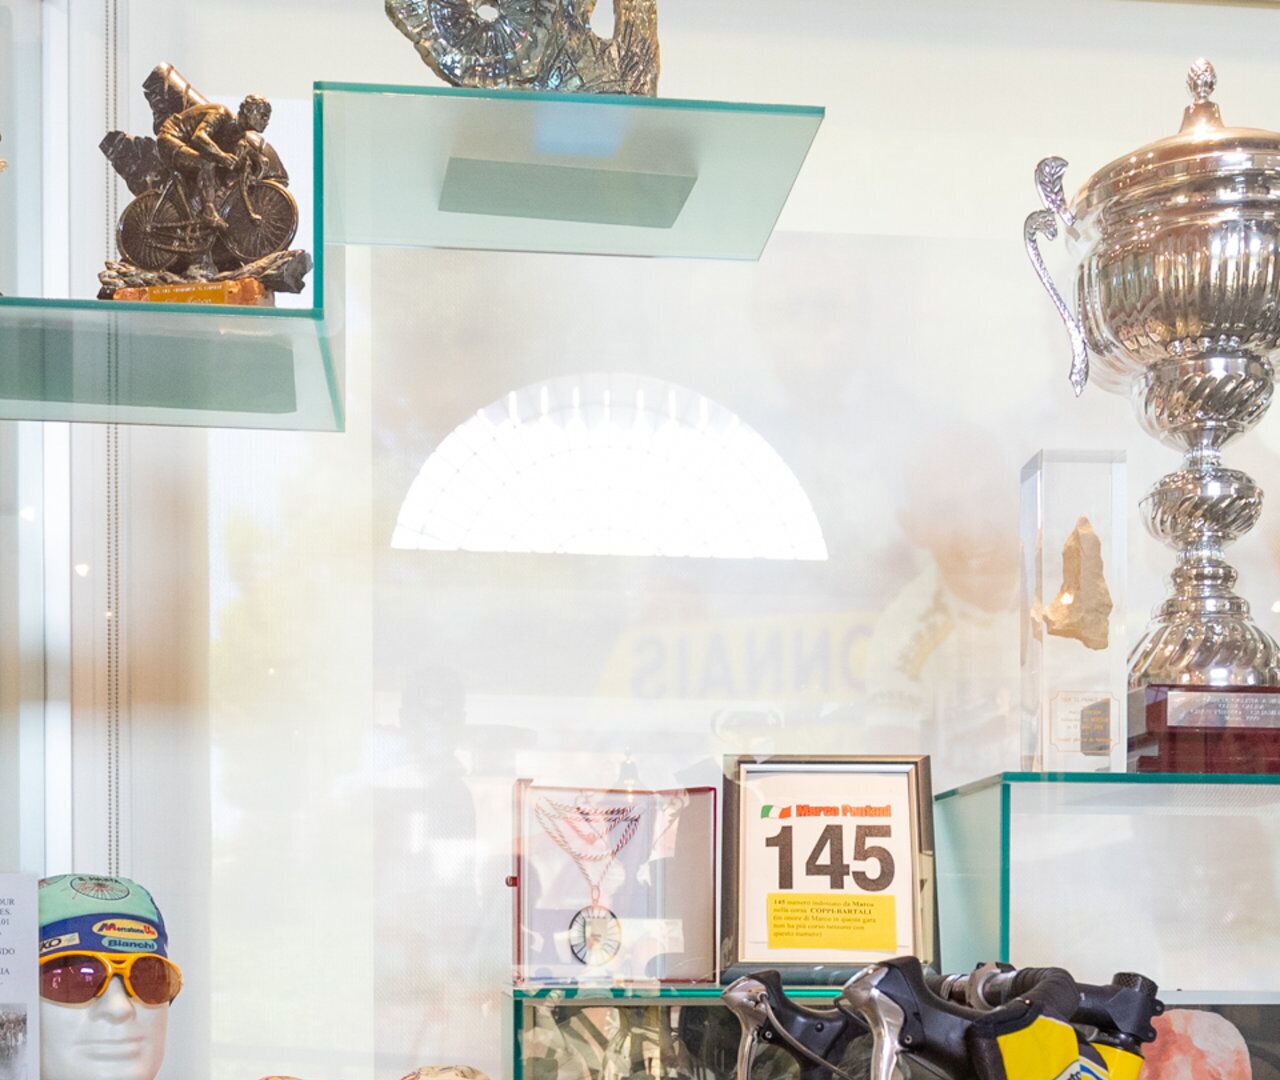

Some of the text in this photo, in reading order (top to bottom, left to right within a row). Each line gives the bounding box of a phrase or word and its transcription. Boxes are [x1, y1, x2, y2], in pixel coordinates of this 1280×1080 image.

[795, 804, 892, 818] Marco Pantani
[765, 824, 896, 892] 145
[107, 939, 155, 950] Bianchi
